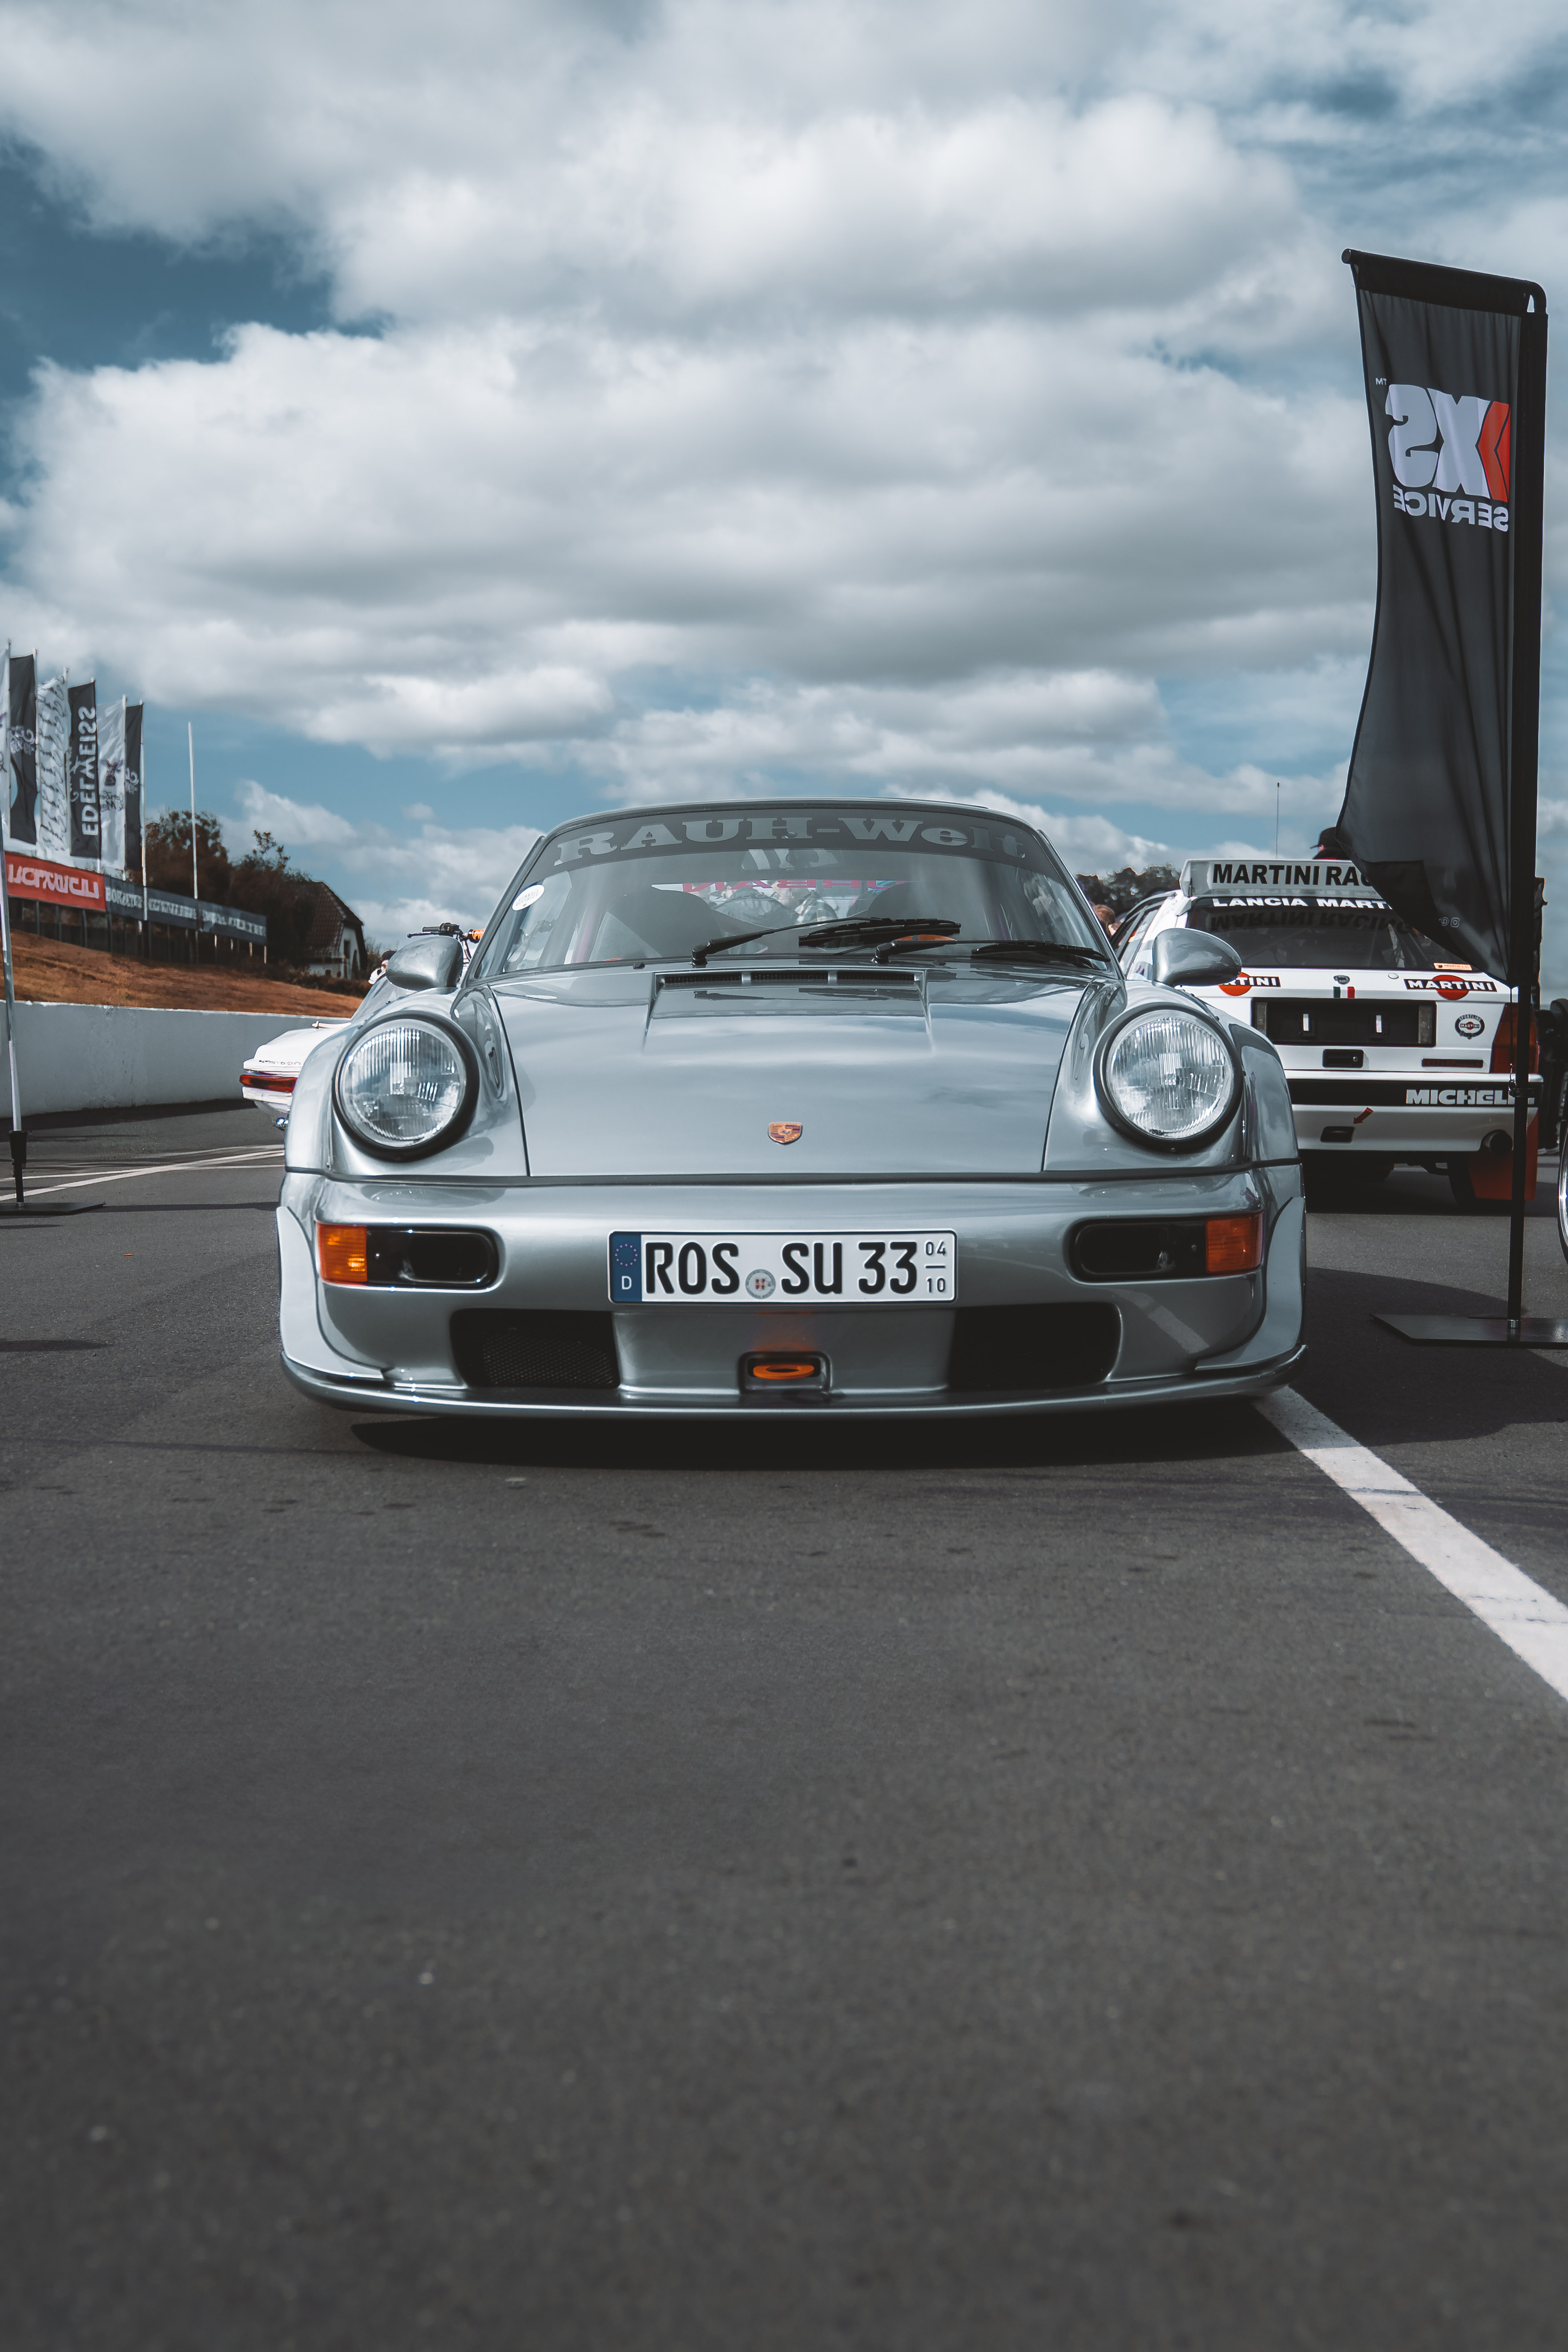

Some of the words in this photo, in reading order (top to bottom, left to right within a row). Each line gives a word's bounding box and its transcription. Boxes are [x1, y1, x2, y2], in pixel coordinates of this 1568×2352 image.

[1213, 863, 1320, 886] MARTINI
[1212, 898, 1308, 906] LANCIA
[1407, 980, 1493, 991] MARTINI
[925, 1241, 946, 1256] 04
[645, 1241, 739, 1295] ROS
[781, 1241, 842, 1295] SU
[858, 1241, 918, 1295] 33
[621, 1275, 632, 1290] D
[927, 1277, 946, 1293] 10
